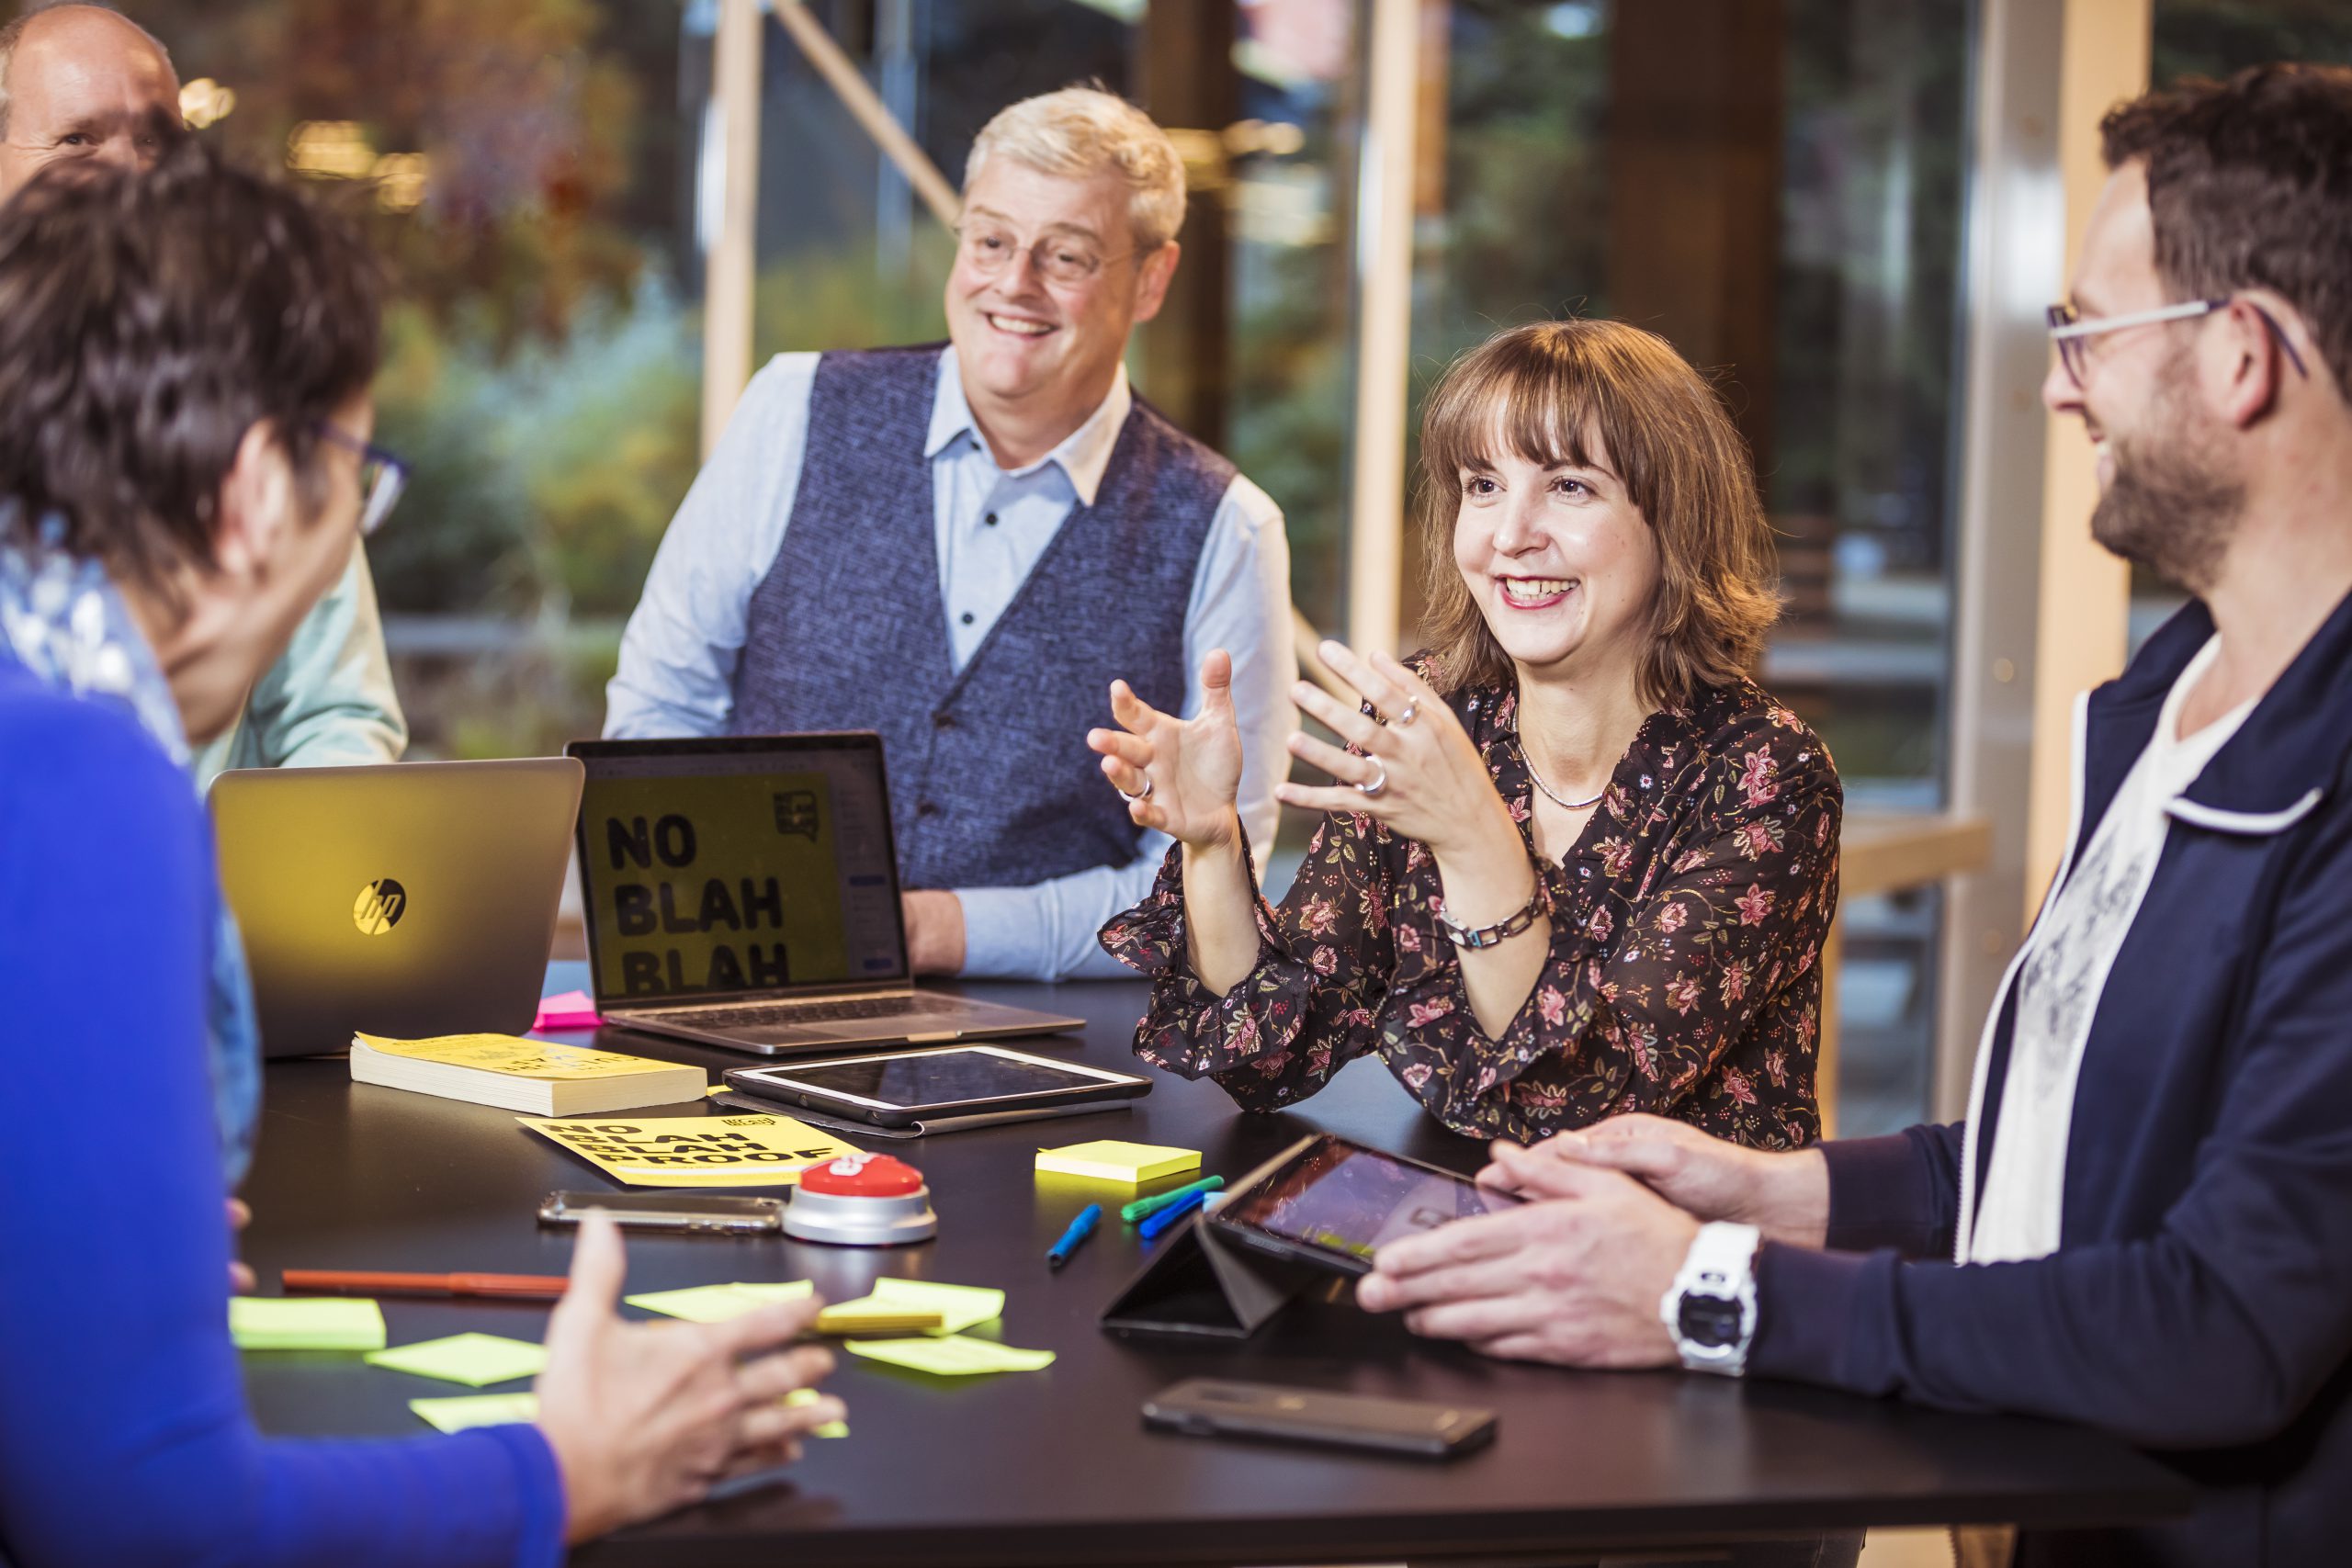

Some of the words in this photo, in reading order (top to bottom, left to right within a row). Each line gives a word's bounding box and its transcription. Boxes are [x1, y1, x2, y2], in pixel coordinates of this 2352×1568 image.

[606, 814, 696, 870] NO
[614, 877, 783, 937] BLAH
[622, 942, 791, 995] BLAH
[541, 1125, 642, 1134] NO
[559, 1133, 750, 1144] BLAH
[576, 1143, 769, 1154] BLAH
[594, 1147, 833, 1164] PROOF
